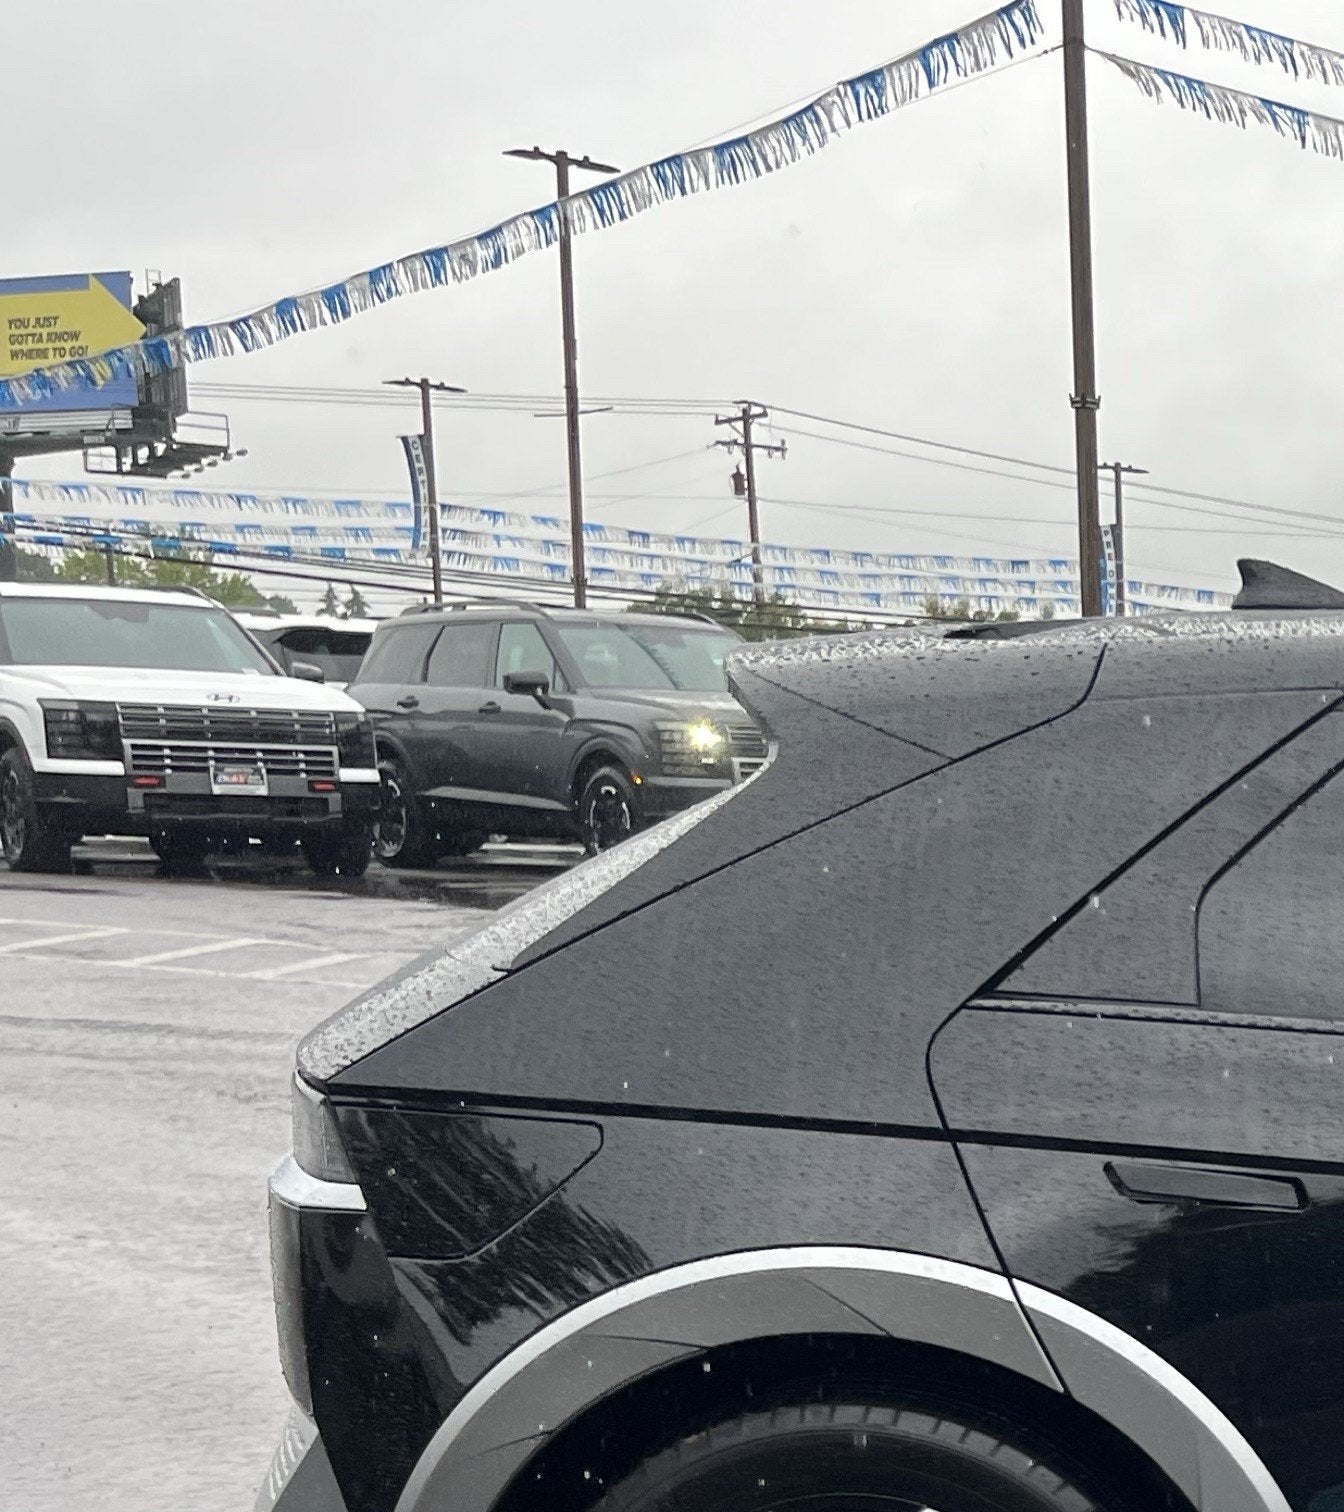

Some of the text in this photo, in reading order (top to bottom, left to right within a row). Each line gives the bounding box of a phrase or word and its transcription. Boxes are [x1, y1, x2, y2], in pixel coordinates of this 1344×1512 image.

[7, 315, 60, 330] YOU JUST
[8, 330, 82, 346] GOTTA KNOW
[9, 345, 89, 361] WHERE TO GO!
